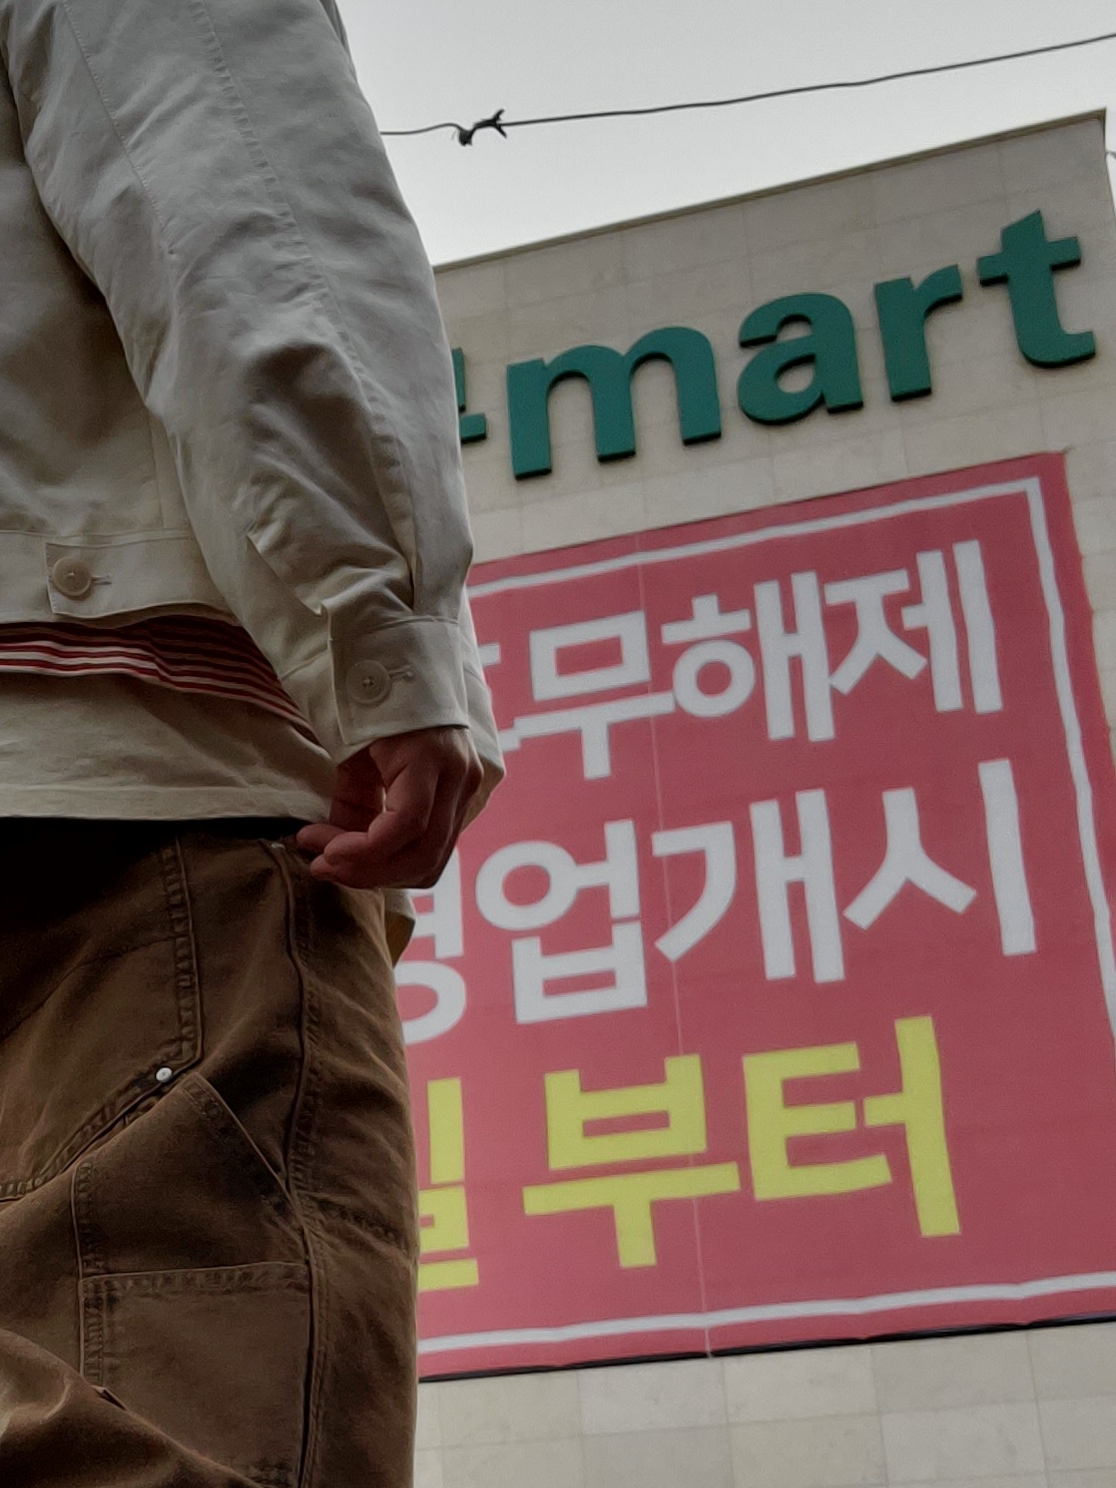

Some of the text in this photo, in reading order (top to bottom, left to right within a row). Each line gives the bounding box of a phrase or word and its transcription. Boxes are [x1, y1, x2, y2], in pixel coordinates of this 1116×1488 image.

[452, 210, 1096, 481] mart
[478, 539, 1004, 780] 무해제
[522, 1014, 962, 1269] 부터
